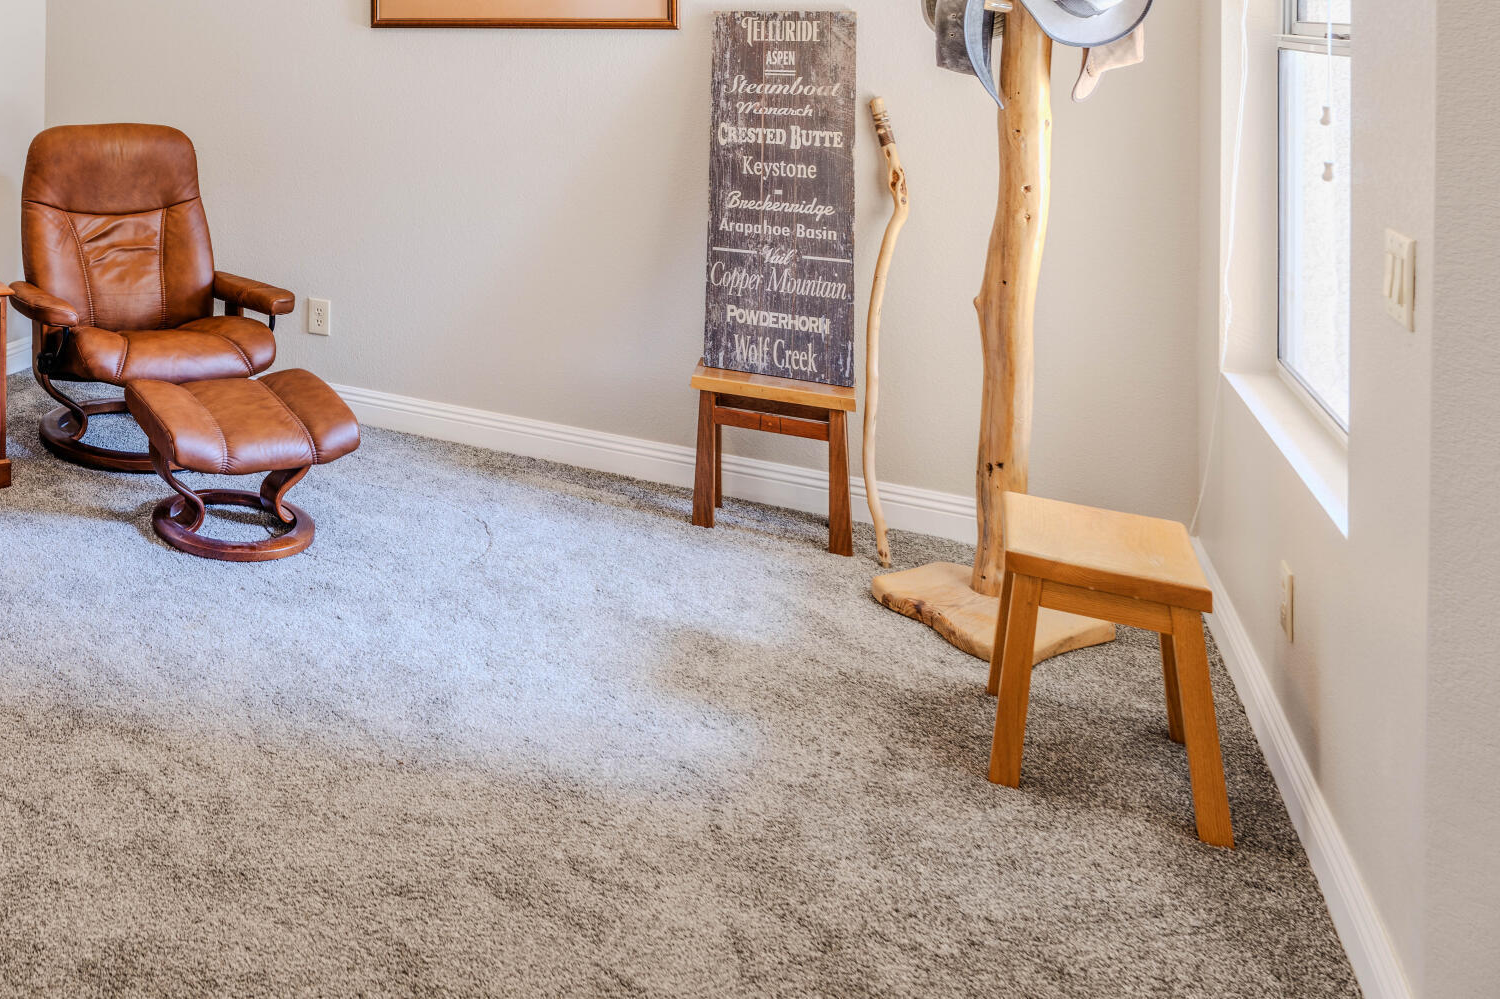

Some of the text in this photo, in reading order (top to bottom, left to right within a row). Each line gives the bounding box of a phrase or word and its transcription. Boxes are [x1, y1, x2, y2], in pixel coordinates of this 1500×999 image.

[741, 16, 821, 47] TELLURIDE
[766, 50, 796, 66] ASPEN
[723, 74, 842, 97] Steamboat
[736, 101, 813, 117] Monarch
[718, 122, 844, 150] CRESTED BUTTE
[742, 155, 817, 180] Keystone
[726, 190, 836, 222] Breckenridge
[719, 218, 837, 241] Arapahoe Basin
[761, 245, 797, 265] Vail
[710, 261, 847, 300] Copper Mountain
[726, 304, 831, 335] POWDERHORN
[733, 333, 818, 373] Wolf Creek
